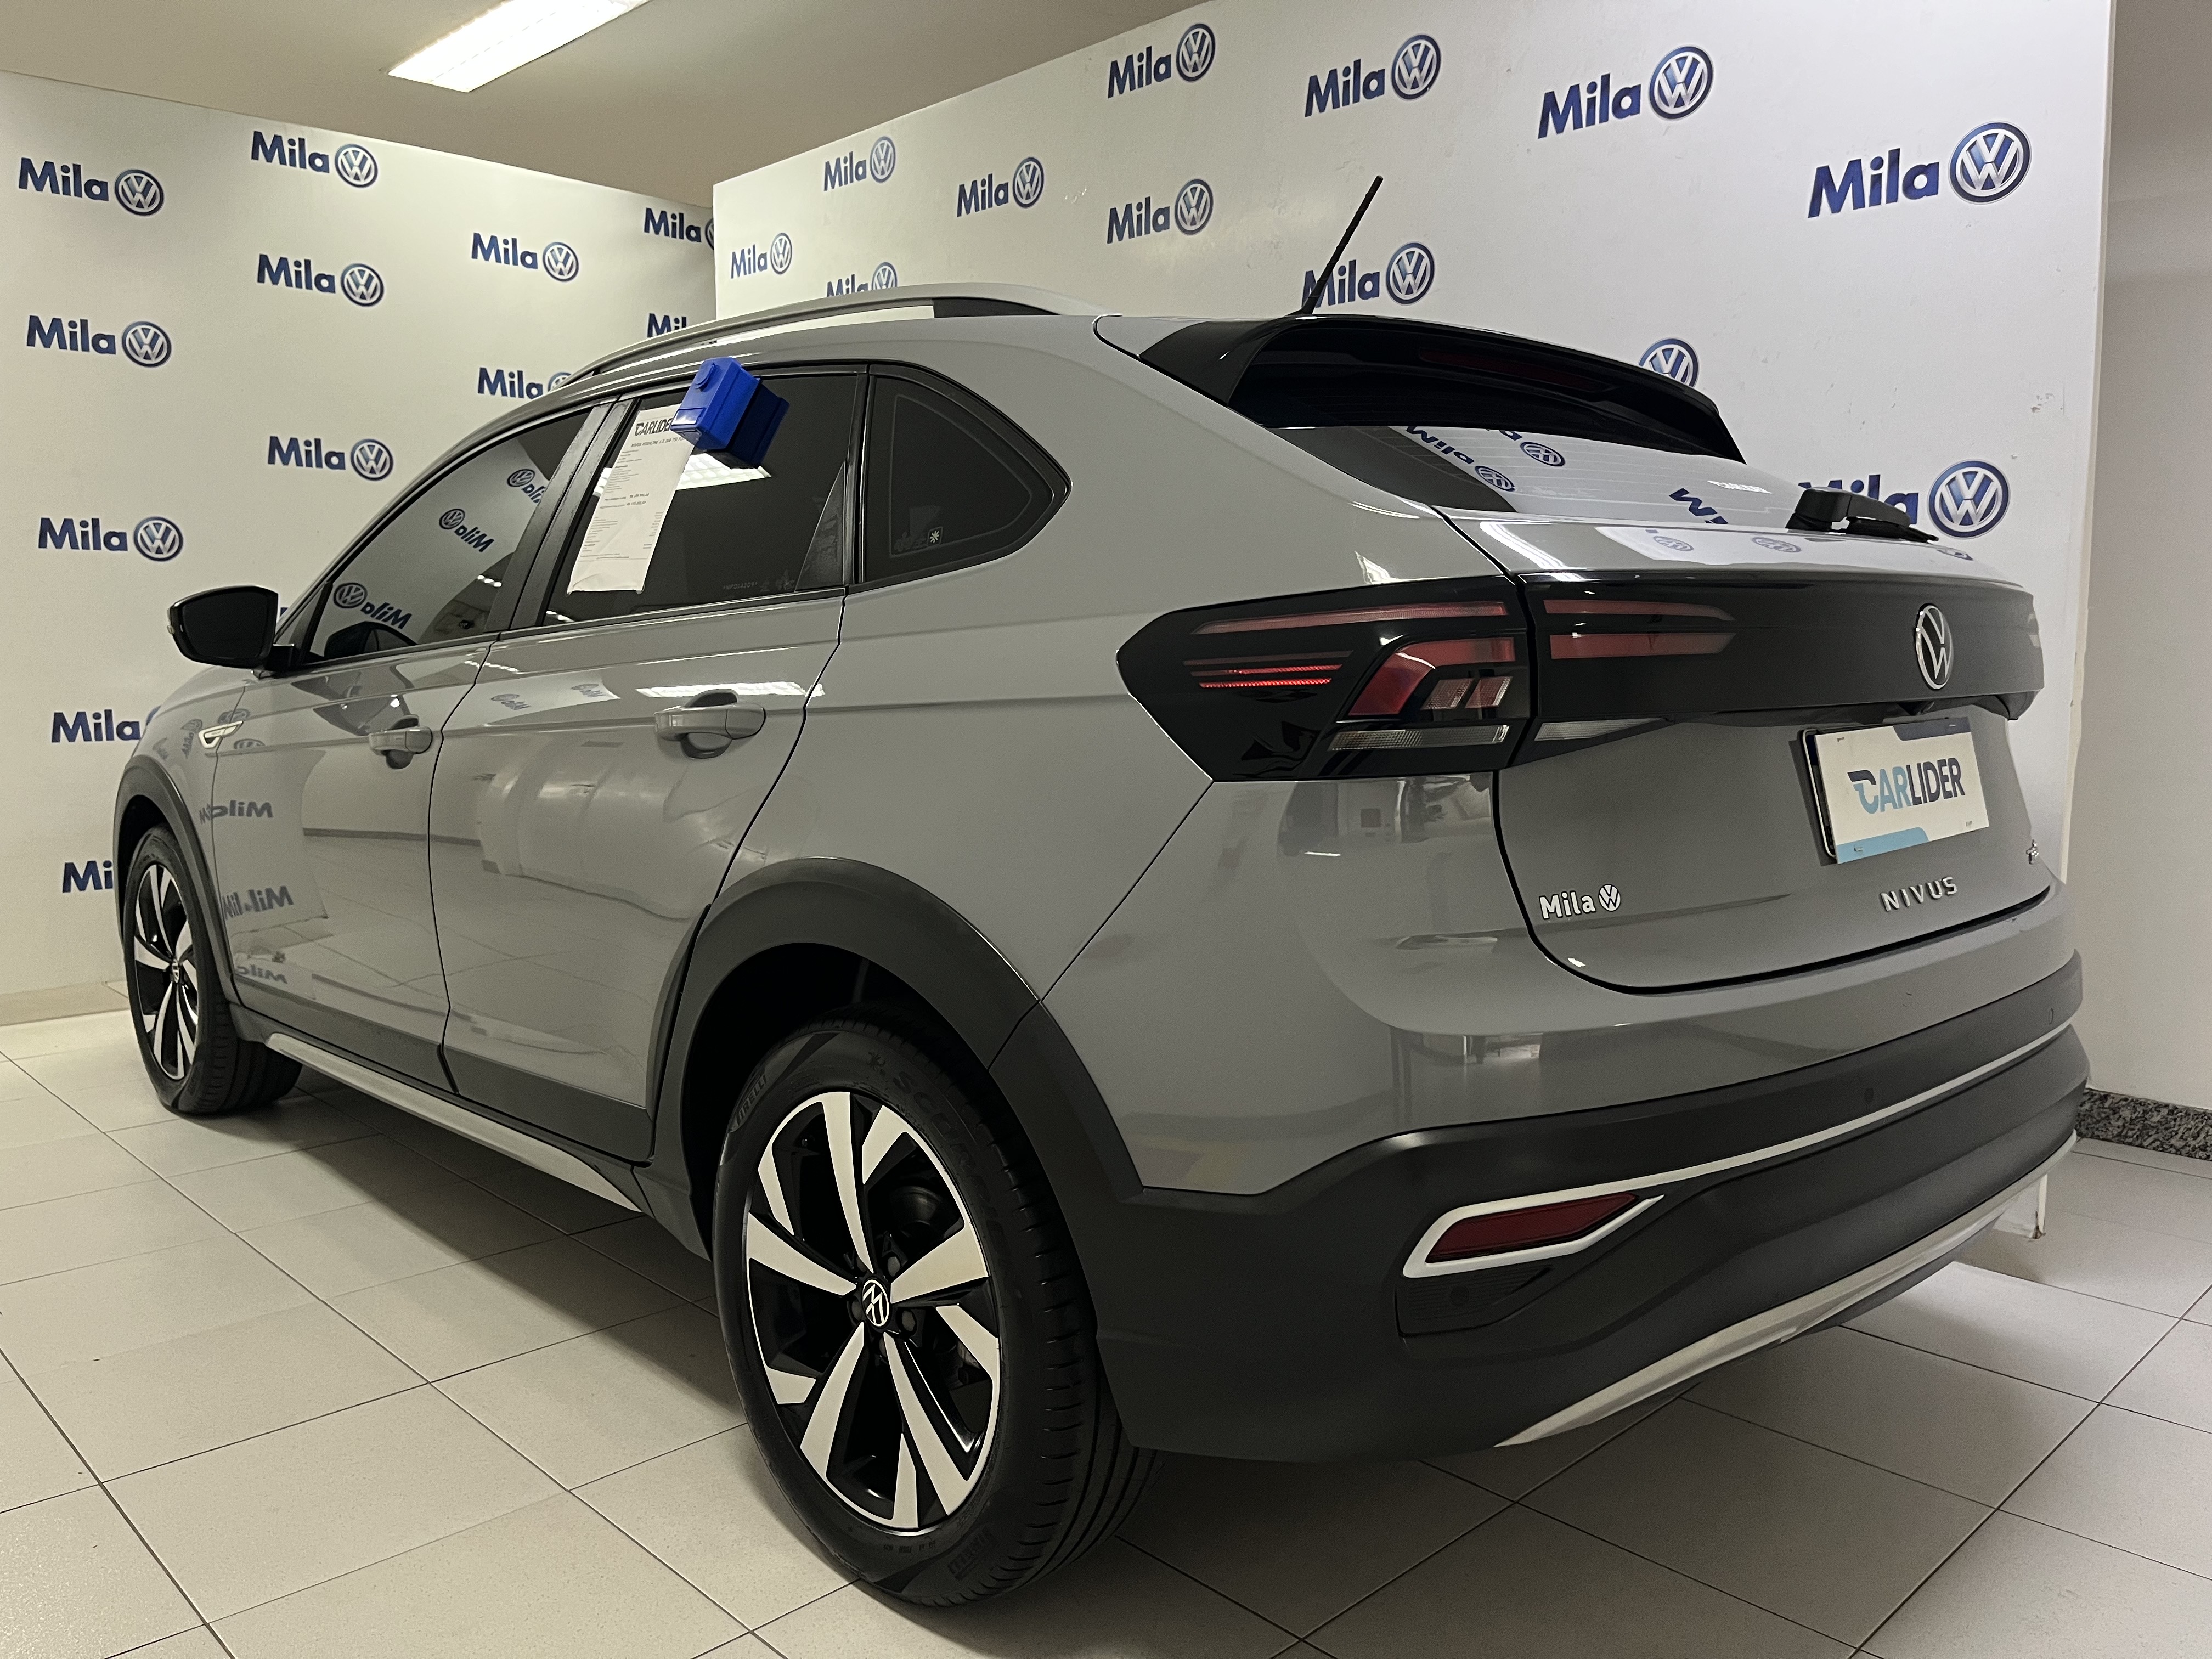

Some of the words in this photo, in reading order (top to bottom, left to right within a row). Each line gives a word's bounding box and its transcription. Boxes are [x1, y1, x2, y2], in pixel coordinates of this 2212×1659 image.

[1107, 46, 1172, 99] Mila
[1305, 59, 1385, 117] Mila
[1538, 74, 1641, 139] Mila
[251, 131, 330, 173] Mila
[823, 152, 867, 191] Mila
[18, 157, 109, 201] Mila
[956, 174, 1009, 217] Mila
[1807, 148, 1939, 218] Mila
[644, 208, 701, 243] Mila
[1107, 196, 1170, 245] Mila
[471, 233, 538, 270] Mila
[731, 244, 768, 279] Mila
[257, 254, 335, 294] Mila
[1301, 260, 1380, 308] Mila
[26, 315, 116, 355] Mila
[477, 367, 544, 399] Mila
[635, 417, 673, 436] CARLIDE
[268, 436, 346, 470] Mila
[38, 517, 128, 552] Mila
[51, 710, 141, 743] Mila
[1847, 758, 1965, 814] CARLIDER
[63, 860, 113, 893] Mi
[1880, 877, 1957, 912] NIVUS
[1539, 890, 1596, 920] Mila
